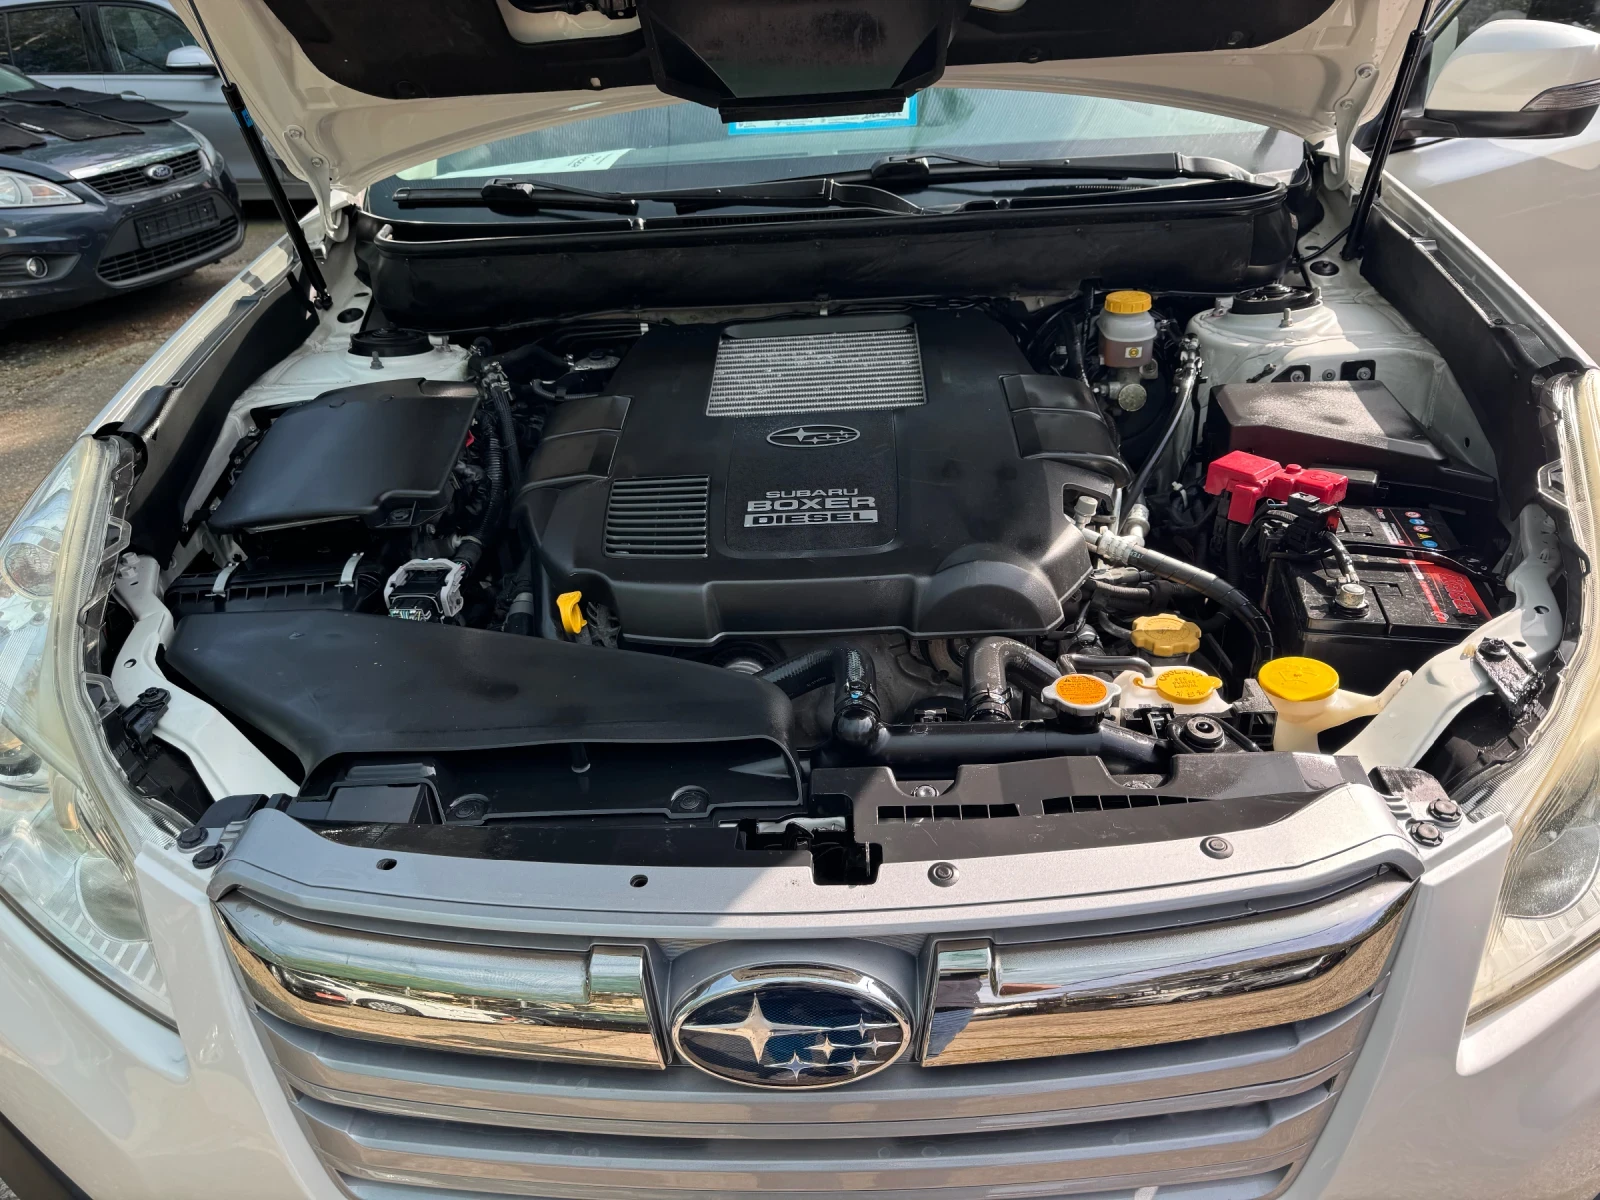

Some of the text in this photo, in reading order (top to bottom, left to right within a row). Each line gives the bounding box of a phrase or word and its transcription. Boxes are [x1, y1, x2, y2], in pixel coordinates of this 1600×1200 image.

[765, 488, 858, 499] SUBARU
[747, 496, 876, 512] BOXER
[751, 511, 874, 526] DIESEL
